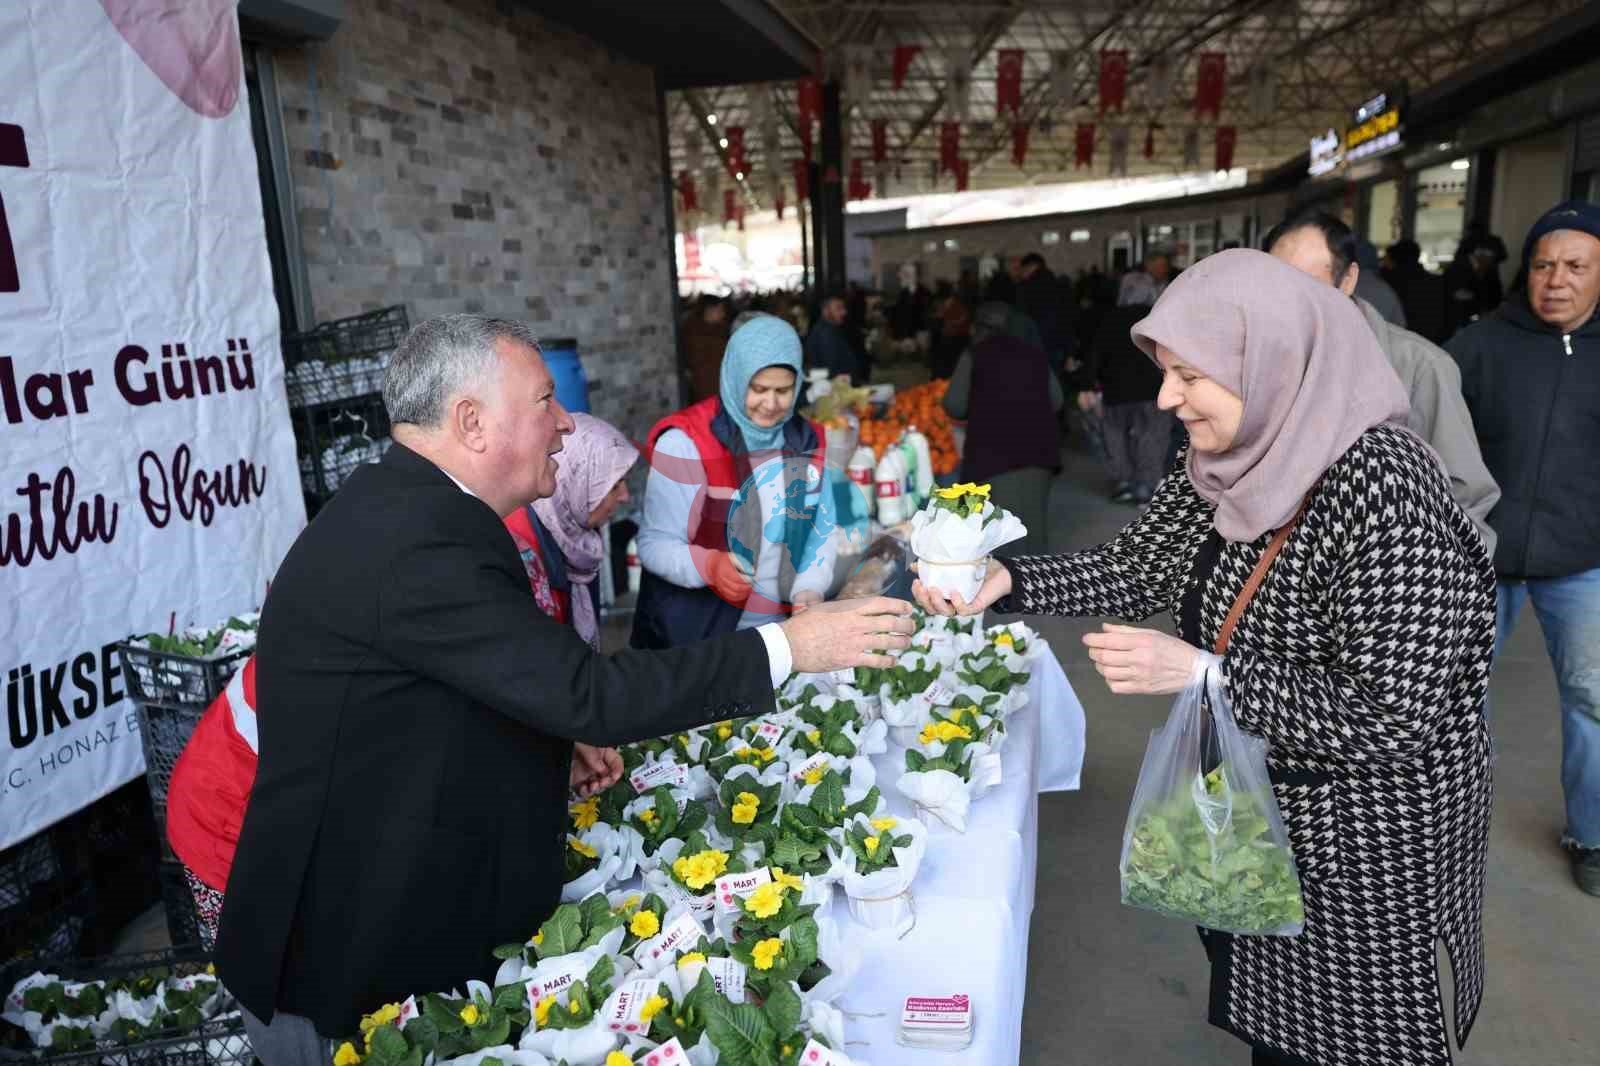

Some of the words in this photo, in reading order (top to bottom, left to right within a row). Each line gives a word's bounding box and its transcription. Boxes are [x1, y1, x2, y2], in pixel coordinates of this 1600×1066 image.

[114, 338, 256, 406] Günü
[138, 443, 266, 528] Olsun
[39, 721, 120, 776] HONAZ
[733, 877, 758, 889] MART
[660, 927, 684, 951] MART
[543, 973, 573, 992] MART
[714, 975, 723, 993] ART
[616, 991, 632, 1019] MART
